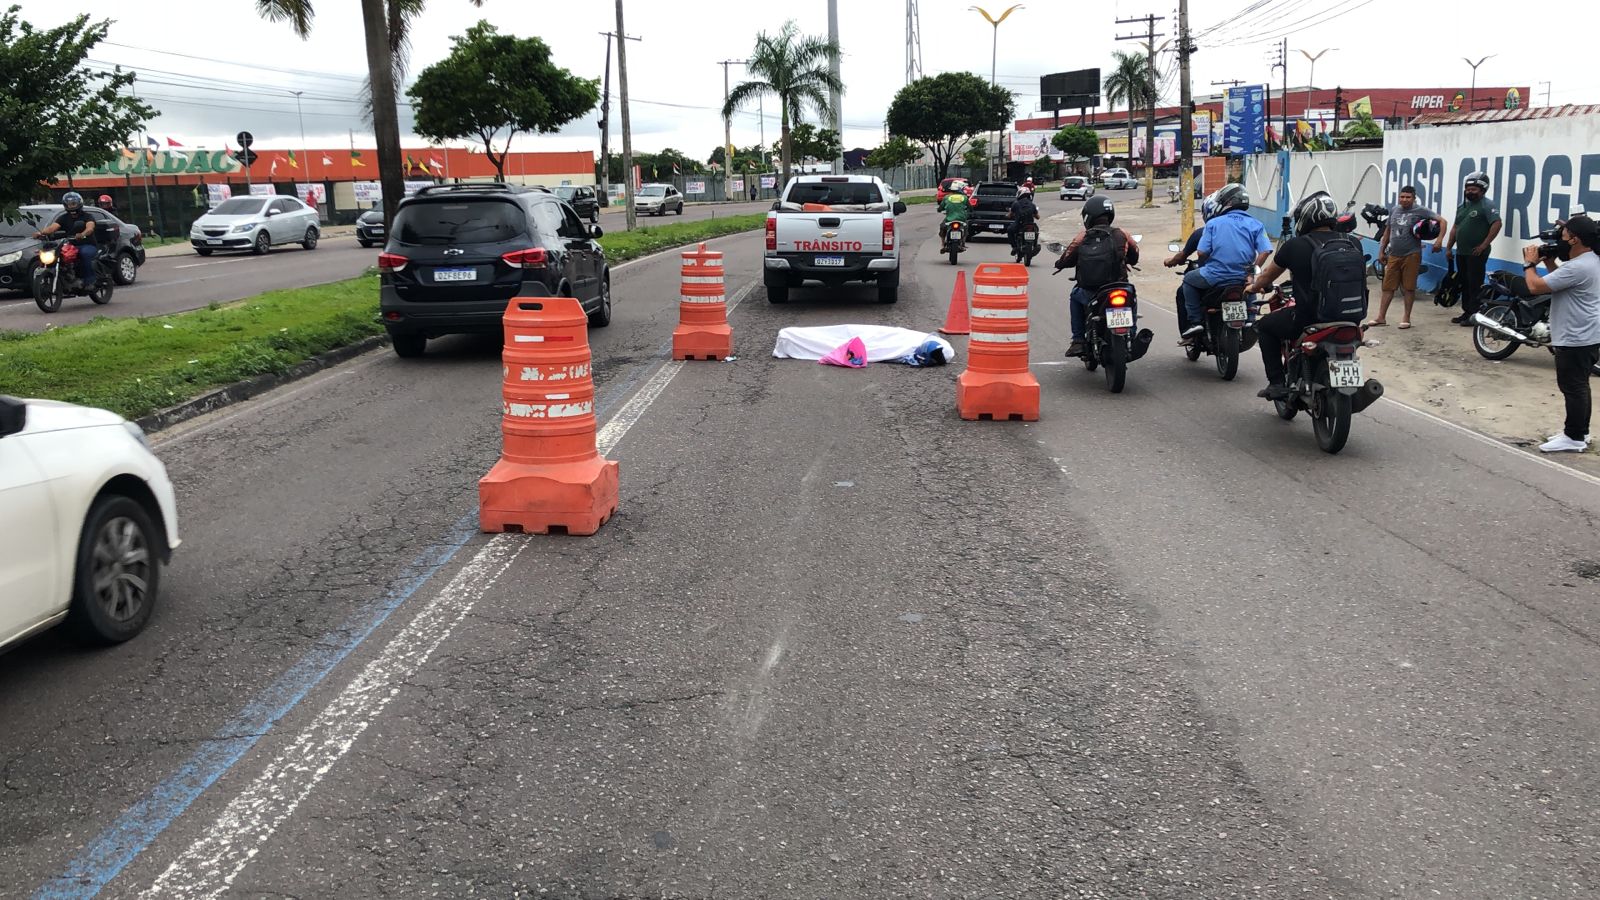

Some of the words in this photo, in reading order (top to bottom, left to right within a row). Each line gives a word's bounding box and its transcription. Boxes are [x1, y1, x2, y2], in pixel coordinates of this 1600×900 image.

[1411, 95, 1444, 108] HIPER
[794, 239, 862, 251] TRÂNSITO
[1112, 311, 1126, 319] PHY
[1224, 306, 1244, 314] PHG
[1225, 312, 1246, 320] 3823
[1334, 366, 1360, 376] PHH
[1335, 376, 1361, 386] 1547
